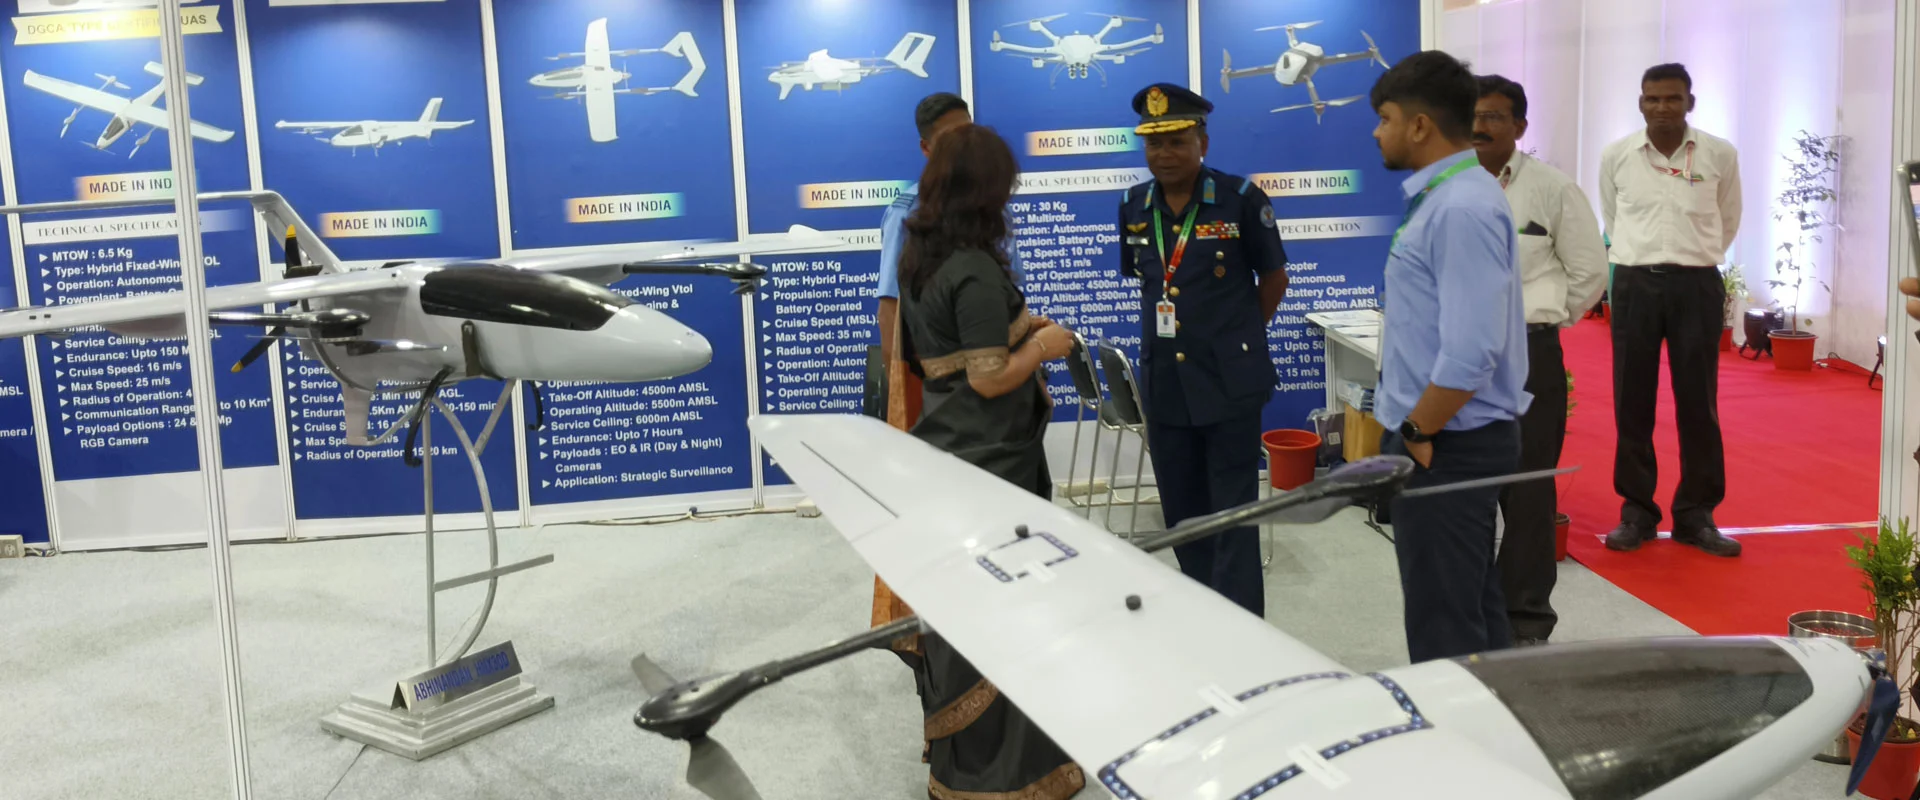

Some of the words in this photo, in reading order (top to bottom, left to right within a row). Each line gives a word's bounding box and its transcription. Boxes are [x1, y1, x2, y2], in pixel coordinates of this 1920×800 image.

[27, 24, 64, 35] DGCA
[181, 14, 207, 25] UAS
[1039, 136, 1073, 148] MADE
[1078, 136, 1089, 147] IN
[1094, 134, 1128, 146] INDIA
[89, 180, 126, 194] MADE
[132, 179, 144, 191] IN
[1054, 174, 1140, 187] SPECIFICATION
[1260, 178, 1294, 191] MADE
[1299, 177, 1311, 189] IN
[1316, 176, 1350, 188] INDIA
[811, 190, 846, 202] MADE
[851, 189, 863, 200] IN
[867, 187, 901, 199] INDIA
[578, 202, 615, 215] MADE
[620, 201, 633, 213] IN
[637, 199, 672, 212] INDIA
[1053, 201, 1067, 213] Kg
[333, 219, 369, 230] MADE
[374, 218, 387, 229] IN
[392, 216, 428, 228] INDIA
[1027, 213, 1076, 224] Multirotor
[37, 223, 107, 237] TECHNICAL
[1052, 223, 1116, 235] Autonomous
[1058, 235, 1094, 248] Battery
[52, 250, 88, 261] MTOW
[98, 248, 114, 259] 6.5
[117, 247, 133, 259] Kg
[1034, 248, 1068, 260] Speed:
[1071, 246, 1082, 257] 10
[1084, 246, 1103, 257] m/s
[54, 266, 84, 278] Type:
[87, 262, 123, 276] Hybrid
[772, 261, 809, 273] MTOW:
[812, 261, 824, 271] 50
[827, 260, 841, 272] Kg
[1023, 260, 1057, 272] Speed:
[1060, 258, 1071, 269] 15
[1073, 258, 1092, 269] m/s
[772, 276, 800, 288] Type:
[802, 275, 836, 287] Hybrid
[1037, 272, 1048, 282] of
[1049, 269, 1101, 283] Operation:
[1103, 269, 1117, 280] up
[56, 278, 114, 292] Operation:
[672, 283, 693, 295] Vtol
[1026, 283, 1041, 294] Off
[1043, 281, 1084, 293] Altitude:
[1086, 279, 1119, 291] 4500m
[1285, 287, 1324, 299] Battery
[1326, 285, 1375, 298] Operated
[773, 289, 832, 302] Propulsion:
[834, 288, 856, 298] Fuel
[1051, 293, 1094, 304] Altitude:
[1096, 291, 1128, 301] 5500m
[776, 305, 812, 315] Battery
[815, 301, 862, 314] Operated
[1041, 305, 1078, 318] Ceiling:
[1081, 303, 1112, 315] 6000m
[1313, 300, 1347, 312] 5000m
[775, 318, 808, 328] Cruise
[810, 316, 843, 329] Speed
[1081, 314, 1118, 326] Camera
[1126, 314, 1140, 326] up
[775, 333, 797, 343] Max
[799, 331, 835, 343] Speed:
[837, 330, 850, 339] 35
[852, 329, 871, 339] m/s
[1091, 327, 1103, 338] kg
[65, 338, 105, 349] Service
[776, 346, 811, 356] Radius
[814, 344, 825, 354] of
[1284, 342, 1310, 353] Upto
[67, 351, 128, 363] Endurance:
[131, 349, 158, 360] Upto
[160, 347, 178, 356] 150
[1298, 353, 1310, 364] 10
[69, 366, 104, 377] Cruise
[107, 363, 144, 375] Speed:
[147, 362, 160, 371] 16
[162, 361, 182, 370] m/s
[777, 359, 830, 372] Operation:
[1286, 367, 1298, 378] 15
[1300, 366, 1320, 378] m/s
[71, 381, 93, 391] Max
[96, 379, 133, 390] Speed:
[136, 378, 148, 387] 25
[151, 376, 171, 386] m/s
[300, 379, 338, 389] Service
[778, 373, 820, 384] Take-Off
[822, 371, 864, 383] Altitude:
[73, 395, 110, 406] Radius
[113, 394, 124, 403] of
[126, 390, 183, 404] Operation:
[302, 394, 335, 404] Cruise
[548, 390, 593, 402] Take-Off
[595, 387, 639, 399] Altitude:
[642, 385, 676, 396] 4500m
[678, 382, 709, 393] AMSL
[778, 386, 829, 399] Operating
[75, 407, 159, 421] Communication
[220, 401, 231, 410] to
[234, 399, 246, 409] 10
[550, 405, 602, 418] Operating
[604, 401, 648, 413] Altitude:
[651, 398, 685, 409] 5500m
[687, 395, 718, 406] AMSL
[779, 401, 817, 411] Service
[819, 399, 858, 412] Ceiling:
[77, 423, 120, 435] Payload
[122, 421, 164, 433] Options
[174, 419, 186, 428] 24
[304, 422, 337, 433] Cruise
[377, 420, 390, 429] 16
[551, 420, 590, 431] Service
[593, 417, 633, 429] Ceiling:
[636, 413, 670, 425] 6000m
[672, 411, 703, 422] AMSL
[80, 439, 105, 449] RGB
[108, 436, 149, 446] Camera
[305, 437, 326, 446] Max
[552, 433, 612, 445] Endurance:
[615, 431, 640, 442] Upto
[652, 427, 683, 438] Hours
[307, 451, 341, 461] Radius
[442, 446, 458, 456] km
[553, 448, 602, 461] Payloads
[611, 445, 627, 455] EO
[640, 443, 651, 453] IR
[654, 441, 678, 453] (Day
[691, 437, 723, 450] Night)
[555, 462, 602, 473] Cameras
[555, 475, 618, 489] Application:
[621, 470, 667, 482] Strategic
[670, 466, 733, 479] Surveillance
